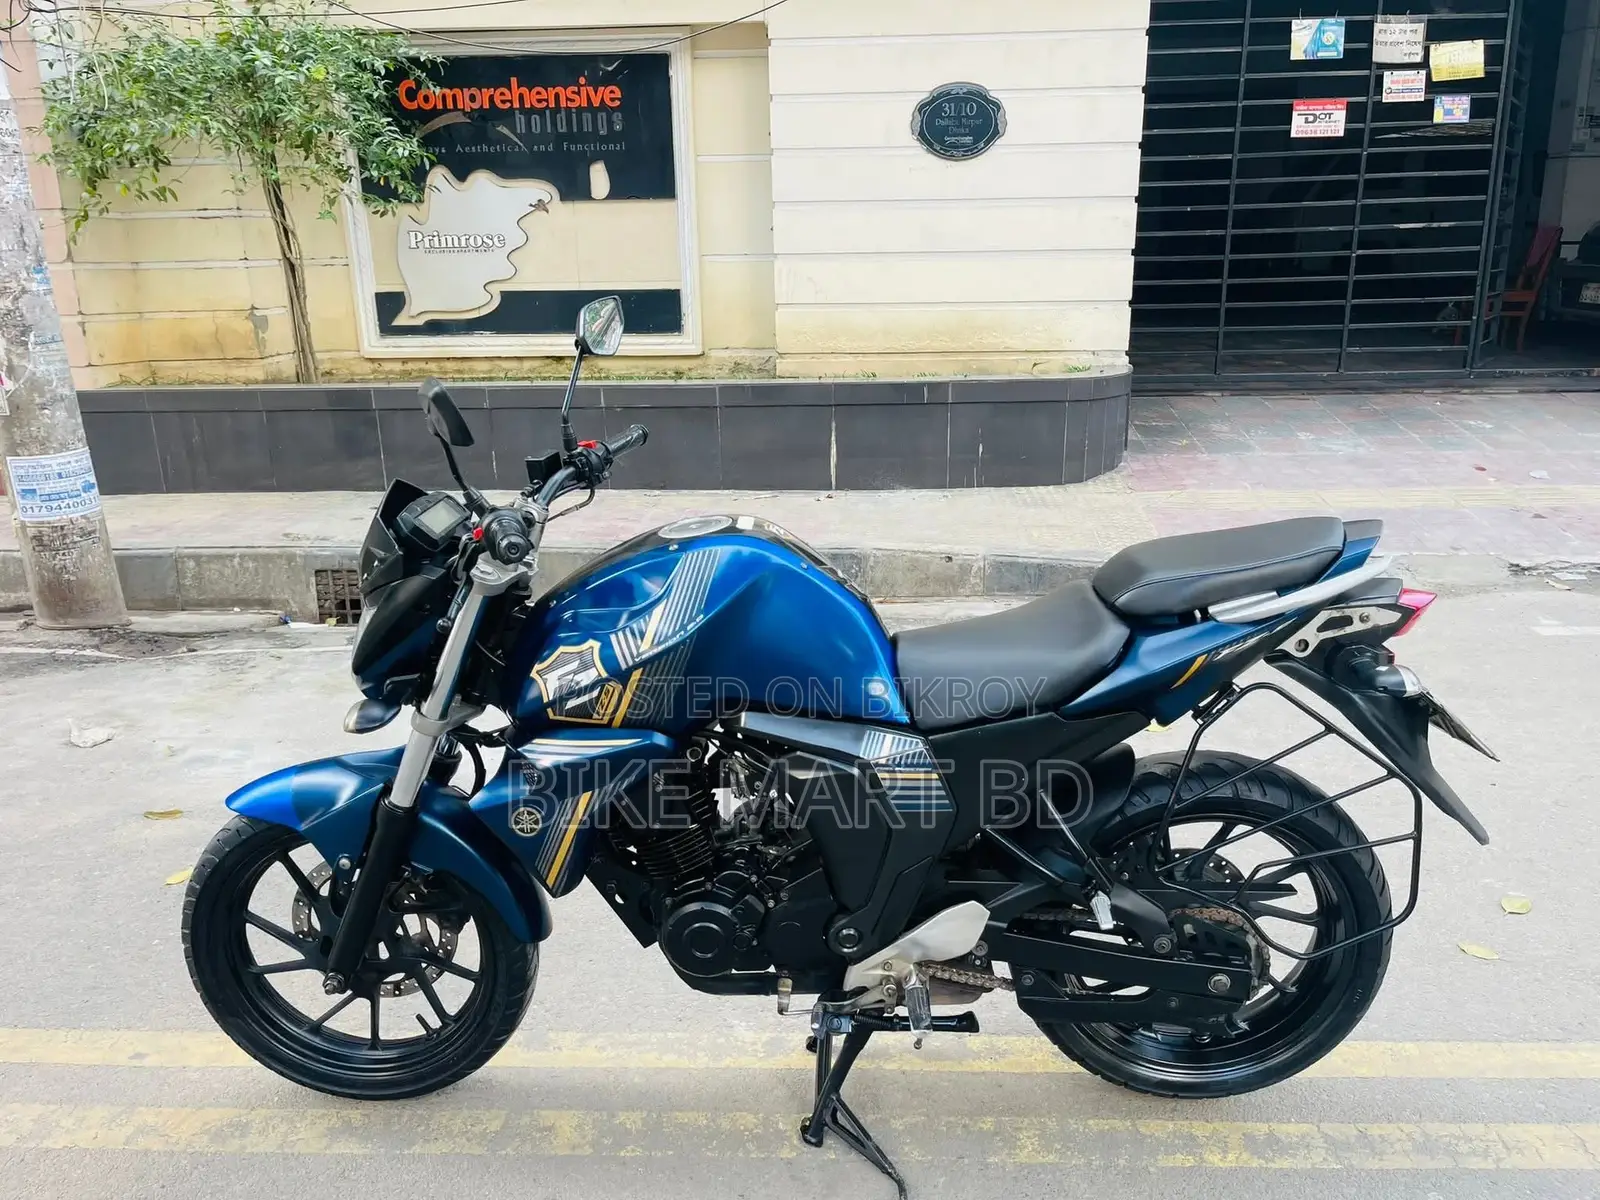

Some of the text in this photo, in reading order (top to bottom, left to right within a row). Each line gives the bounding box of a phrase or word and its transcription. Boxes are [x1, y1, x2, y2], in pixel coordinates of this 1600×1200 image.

[398, 76, 622, 112] Comprehensive
[941, 102, 977, 117] 31/10
[514, 110, 624, 135] holdings
[532, 142, 553, 152] and
[563, 141, 626, 151] Functional
[408, 230, 506, 249] Primrose
